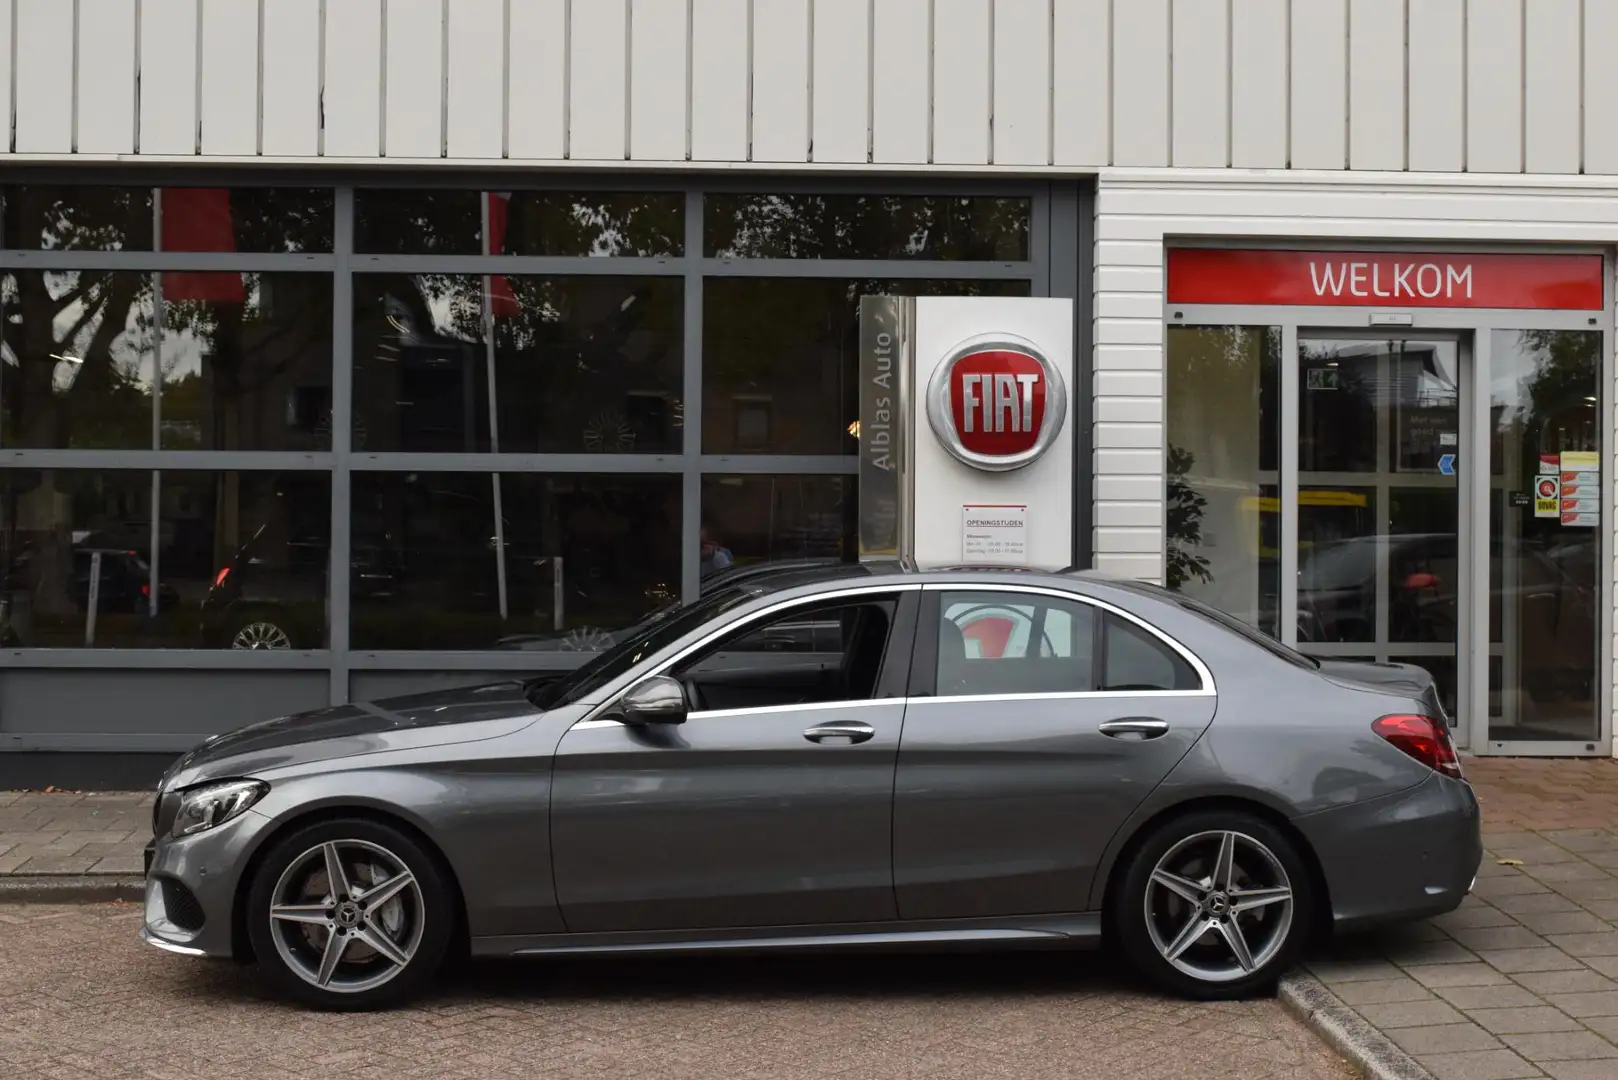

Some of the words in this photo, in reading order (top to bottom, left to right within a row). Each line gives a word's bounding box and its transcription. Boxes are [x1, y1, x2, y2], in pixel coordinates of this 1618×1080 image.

[1309, 261, 1472, 298] WELKOM
[962, 373, 1039, 433] FIAT
[870, 397, 891, 471] Alblas
[966, 519, 1024, 527] OPENINGSTIJDEN
